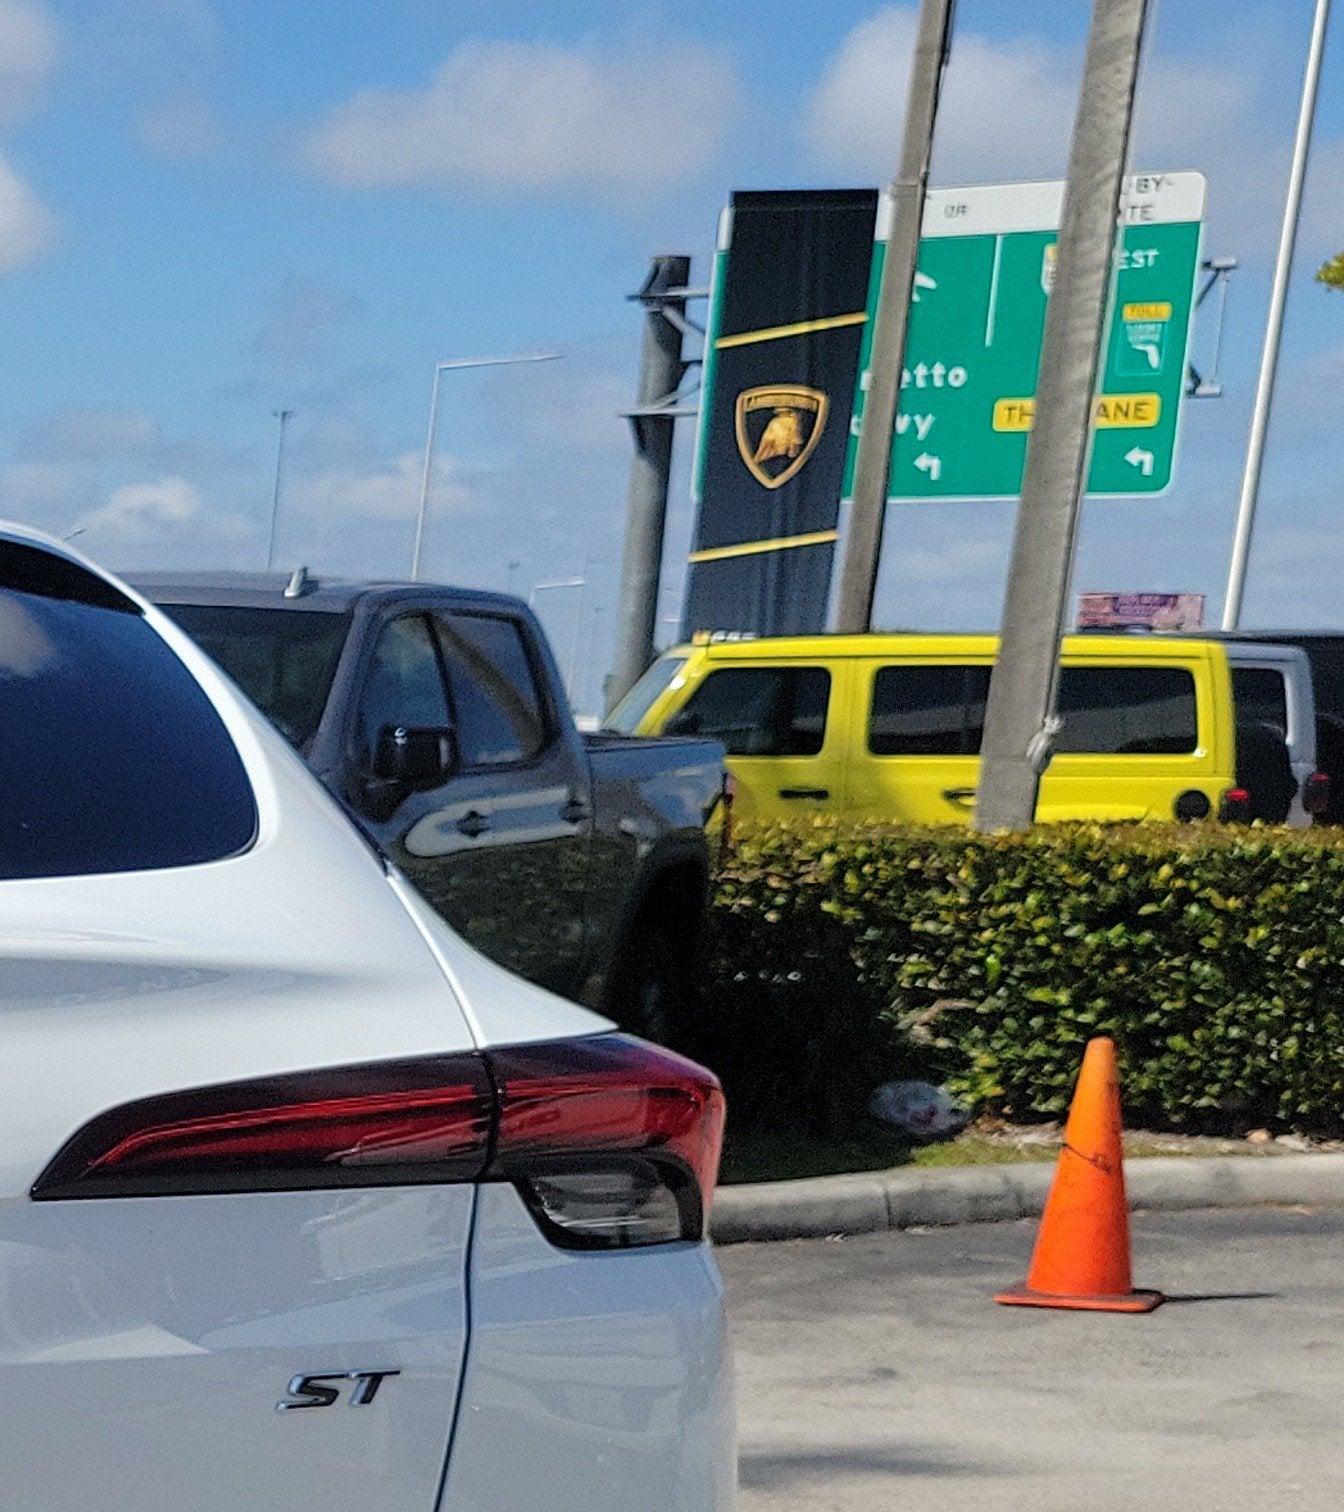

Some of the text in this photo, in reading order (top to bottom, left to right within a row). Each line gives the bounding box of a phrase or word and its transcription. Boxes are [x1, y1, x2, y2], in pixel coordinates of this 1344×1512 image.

[1116, 248, 1160, 270] EST
[1003, 401, 1151, 423] TH ANE
[276, 1368, 401, 1411] ST
